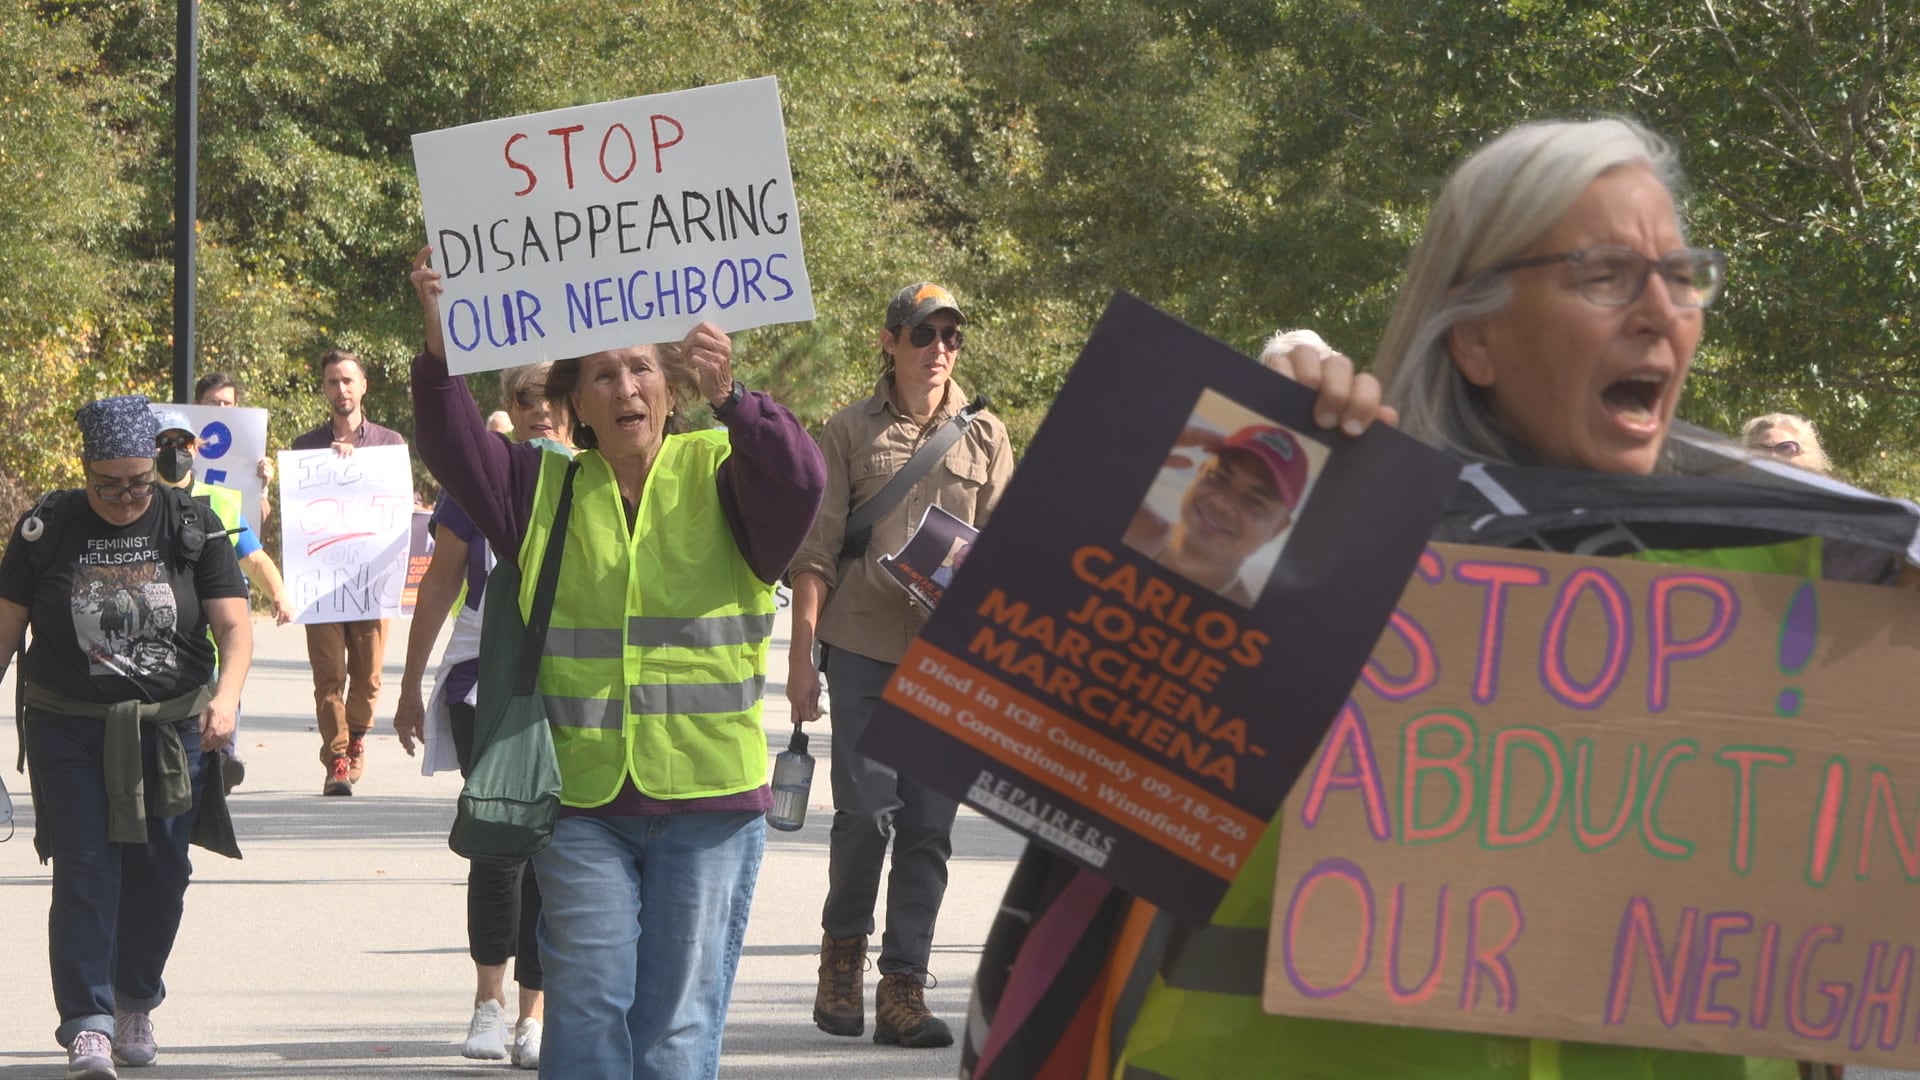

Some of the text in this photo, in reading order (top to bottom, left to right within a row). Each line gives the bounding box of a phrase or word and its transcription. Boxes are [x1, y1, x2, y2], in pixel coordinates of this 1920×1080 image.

[504, 114, 685, 197] STOP
[438, 178, 788, 279] DISAPPEARING
[448, 253, 794, 351] OUR NEIGHBORS
[79, 550, 160, 565] HELLSCAPE
[87, 536, 150, 551] FEMINIST
[1066, 595, 1227, 694] JOSUE
[1070, 544, 1271, 668] CARLOS
[968, 626, 1237, 790] MARCHENA
[976, 588, 1267, 760] MARCHENA-
[896, 675, 1238, 870] Winn Correctional, Winnfield, LA
[917, 657, 1248, 841] Died in ICE Custody 09/18/26
[1300, 697, 1920, 890] ABDUCTIN
[976, 770, 1117, 853] REPAIRERS
[1282, 857, 1920, 1052] OUR NEIGH
